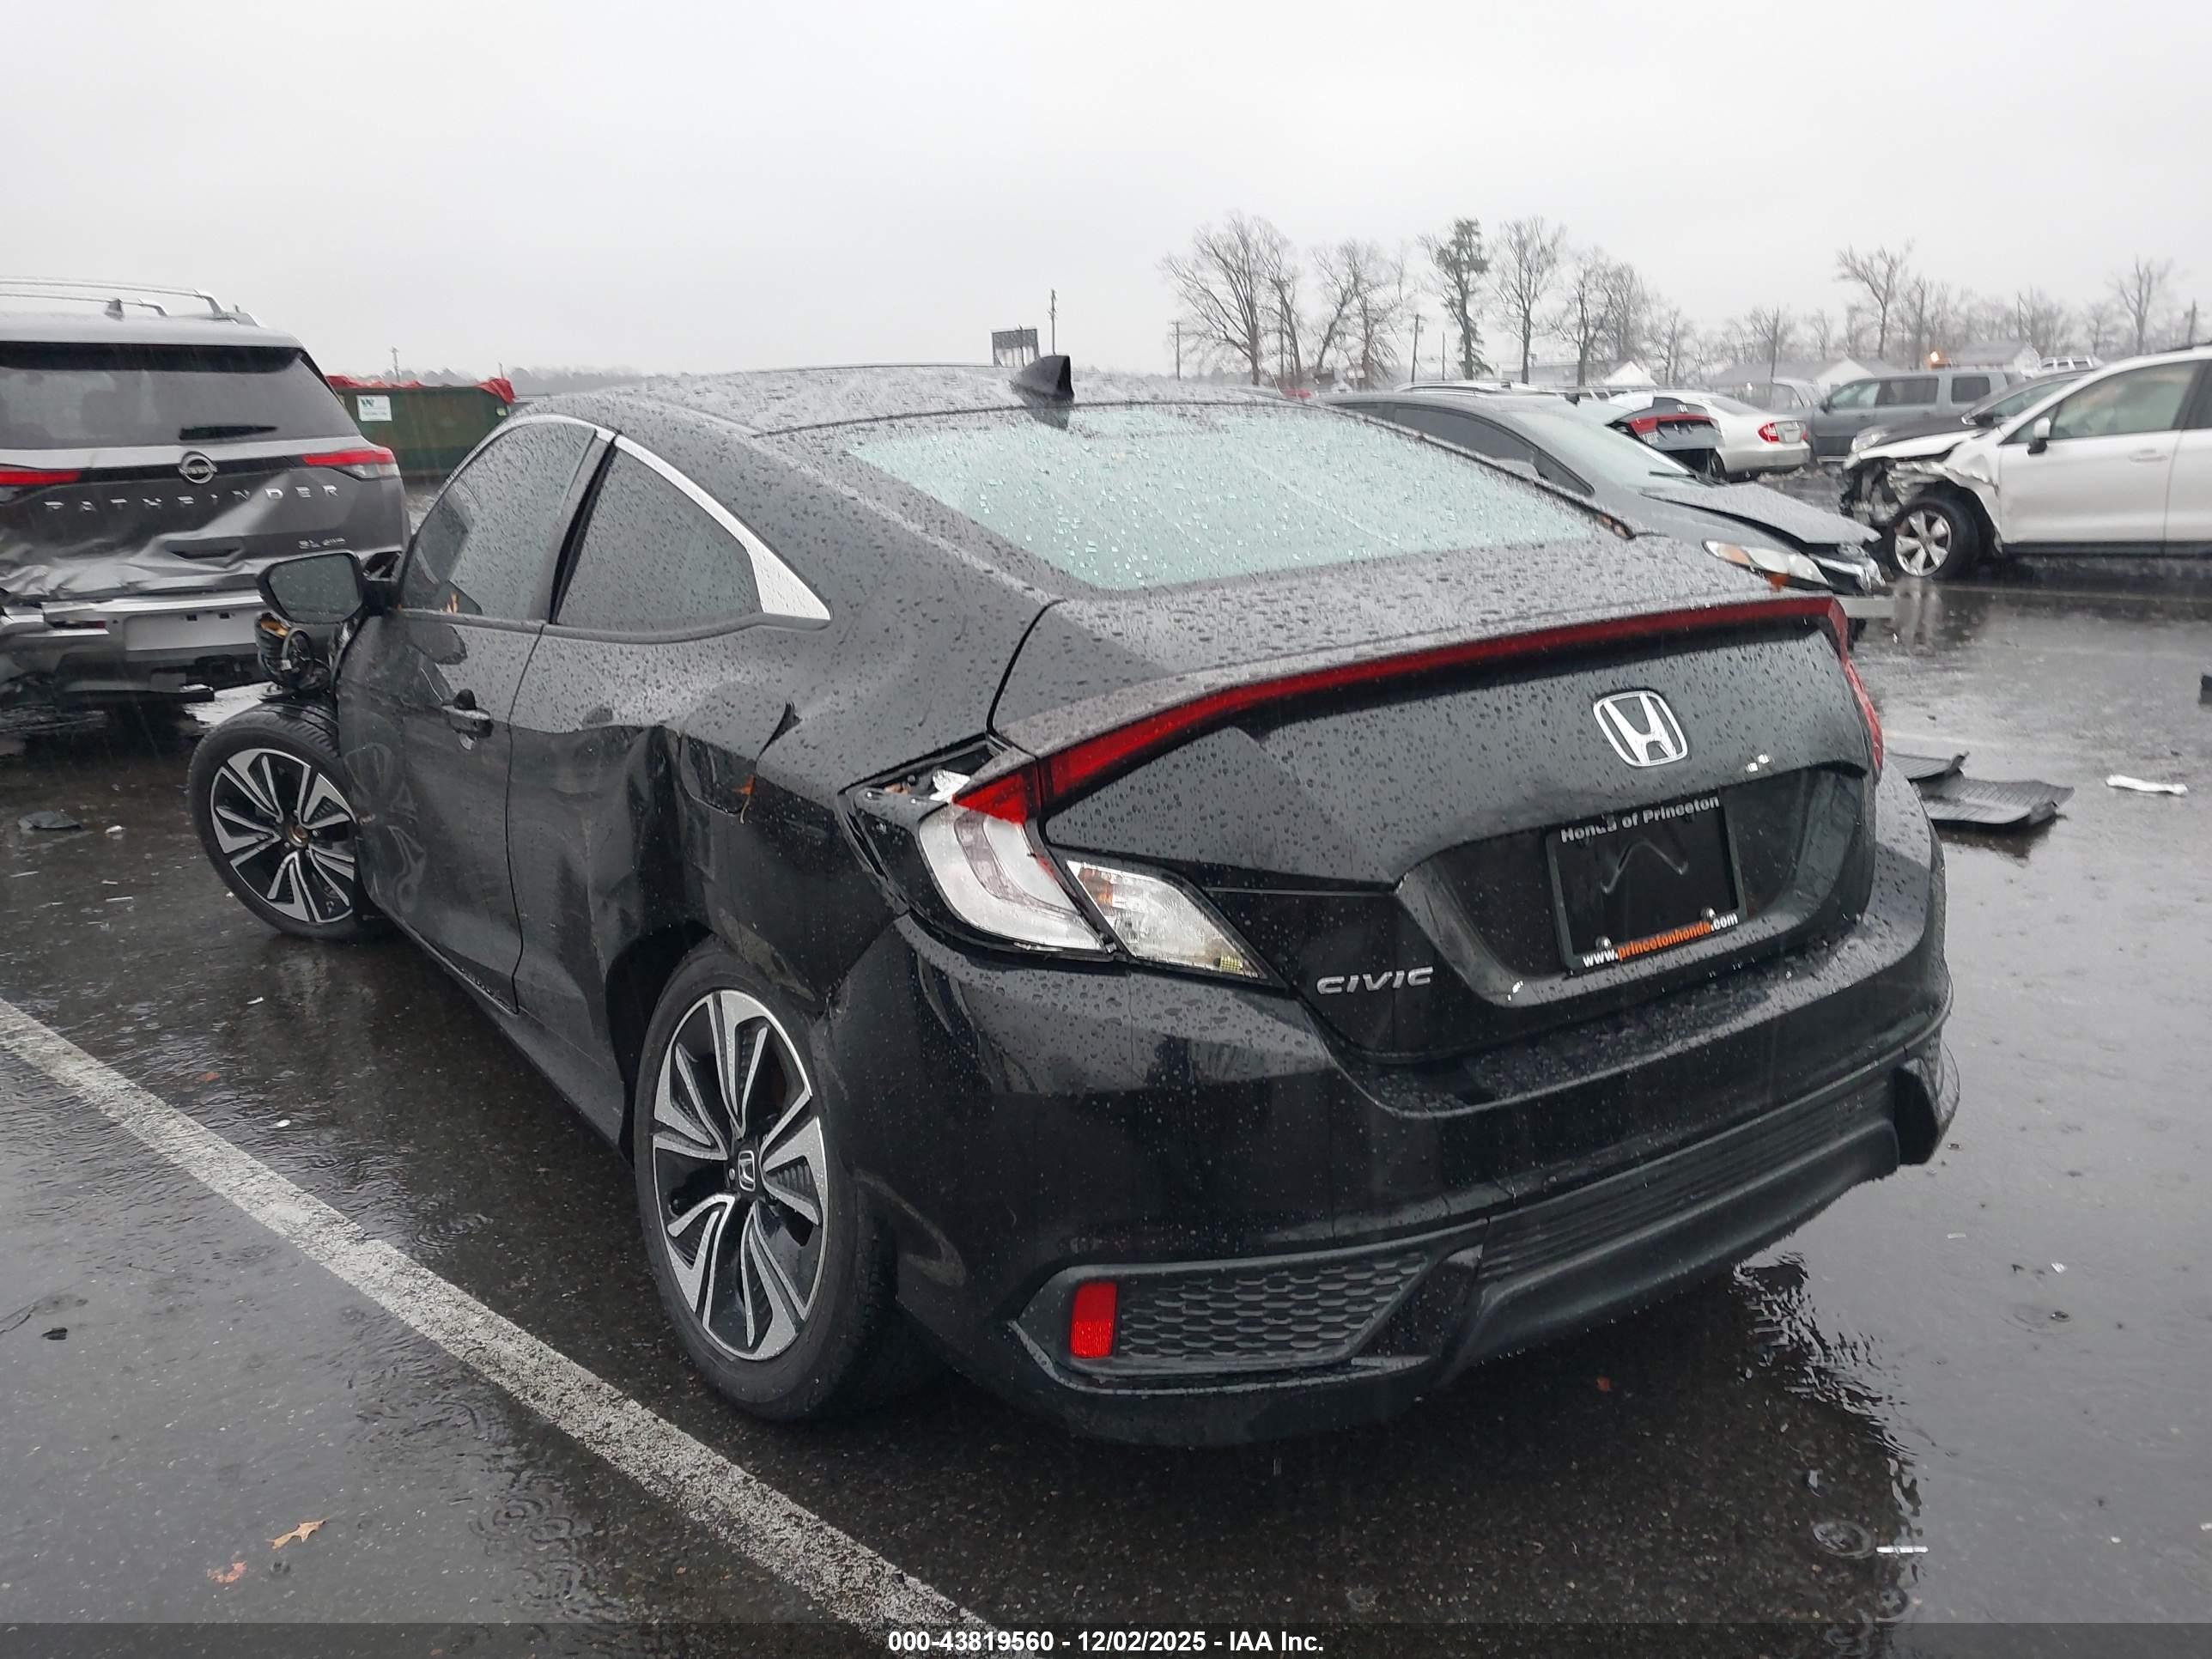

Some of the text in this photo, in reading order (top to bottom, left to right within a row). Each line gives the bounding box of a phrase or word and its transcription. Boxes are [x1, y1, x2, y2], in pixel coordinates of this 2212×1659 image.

[1622, 811, 1638, 829] of
[1642, 796, 1720, 824] Princeton
[1582, 912, 1739, 968] www.princetonhonda.com
[1316, 966, 1433, 995] CIVIC
